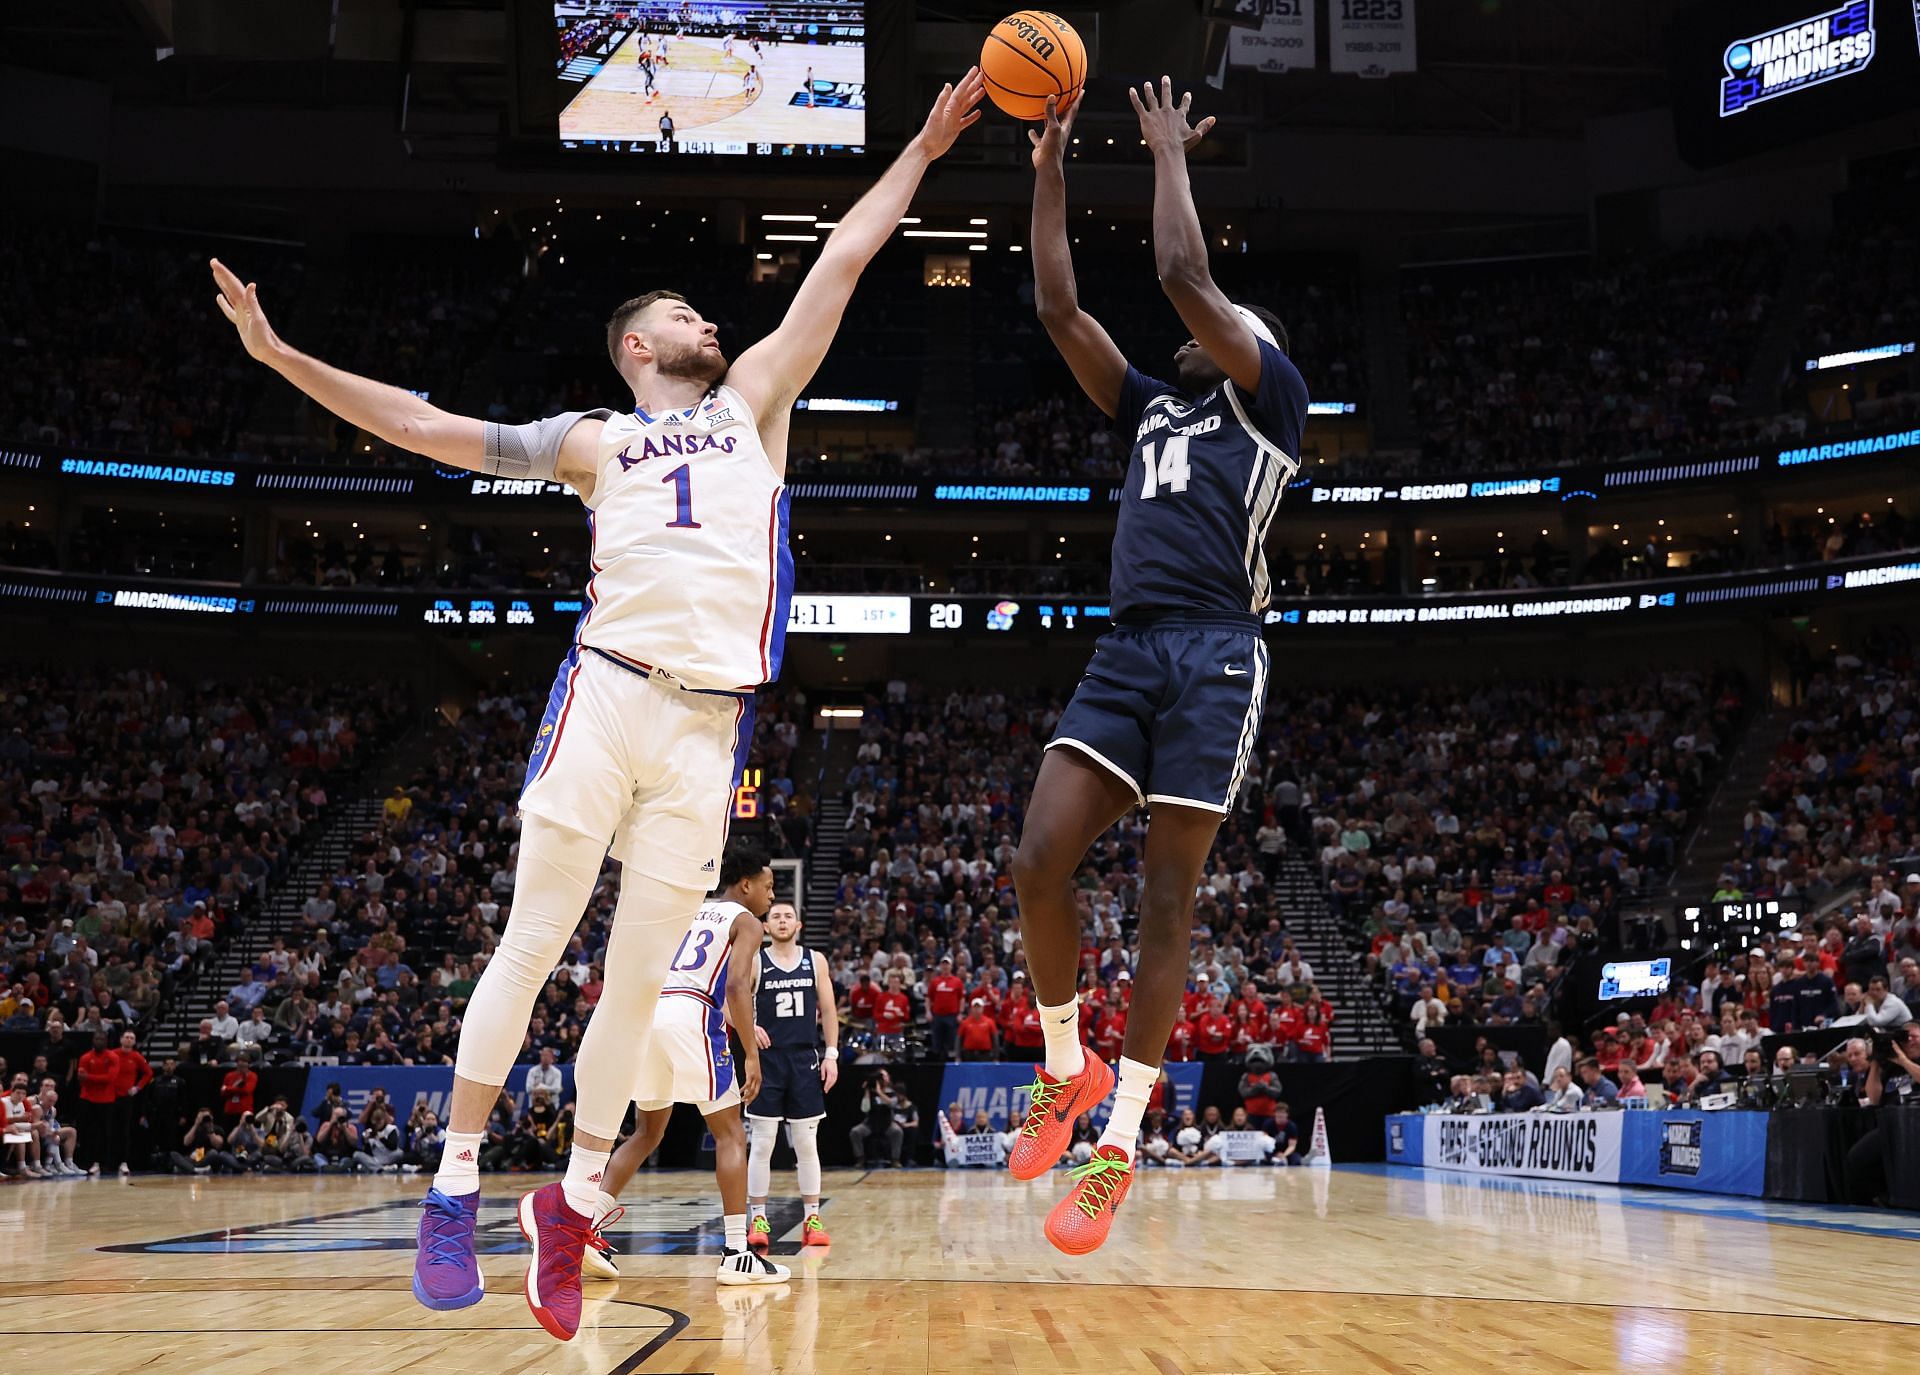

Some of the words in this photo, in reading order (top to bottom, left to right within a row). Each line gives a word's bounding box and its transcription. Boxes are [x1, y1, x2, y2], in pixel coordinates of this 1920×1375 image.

[1002, 17, 1055, 61] Wilson
[1241, 36, 1304, 49] 1974-2009
[1751, 18, 1830, 67] MARCH
[1763, 31, 1871, 88] MADNESS
[655, 141, 670, 153] 13
[685, 141, 715, 154] 14:11
[756, 143, 773, 155] 20
[616, 434, 737, 473] KANSAS
[1777, 429, 1920, 467] #MARCHMADNE
[61, 458, 236, 487] #MARCHMADNESS
[1140, 435, 1192, 500] 14
[492, 479, 546, 495] FIRST
[661, 463, 702, 529] 1
[934, 485, 1091, 502] #MARCHMADNESS
[1332, 486, 1383, 502] FIRST
[1400, 483, 1468, 501] SECOND
[1470, 479, 1542, 497] ROUNDS
[1844, 562, 1920, 589] MARCHMA
[114, 590, 237, 614] MARCHMADNESS
[553, 601, 582, 612] BONUS
[1306, 610, 1347, 624] 2024
[1370, 608, 1416, 623] MEN'S
[1418, 604, 1510, 622] BASKETBALL
[1512, 597, 1631, 617] CHAMPIONSHIP
[423, 610, 463, 624] 41.7%
[506, 610, 534, 624] 50%
[862, 610, 885, 621] 1ST
[929, 603, 963, 629] 20
[1041, 616, 1052, 629] 4
[1065, 616, 1075, 629] 1
[736, 786, 756, 818] 6
[694, 911, 728, 924] CKSON
[670, 929, 714, 972] 13
[764, 978, 813, 990] SAMFORD
[775, 991, 805, 1018] 21
[965, 1136, 994, 1144] MAKE
[1440, 1120, 1468, 1166] FIRST
[1478, 1118, 1527, 1168] SECOND
[1528, 1119, 1597, 1173] ROUNDS
[1668, 1124, 1691, 1145] MARCH
[966, 1144, 993, 1153] SOME
[1671, 1145, 1700, 1168] MADNESS
